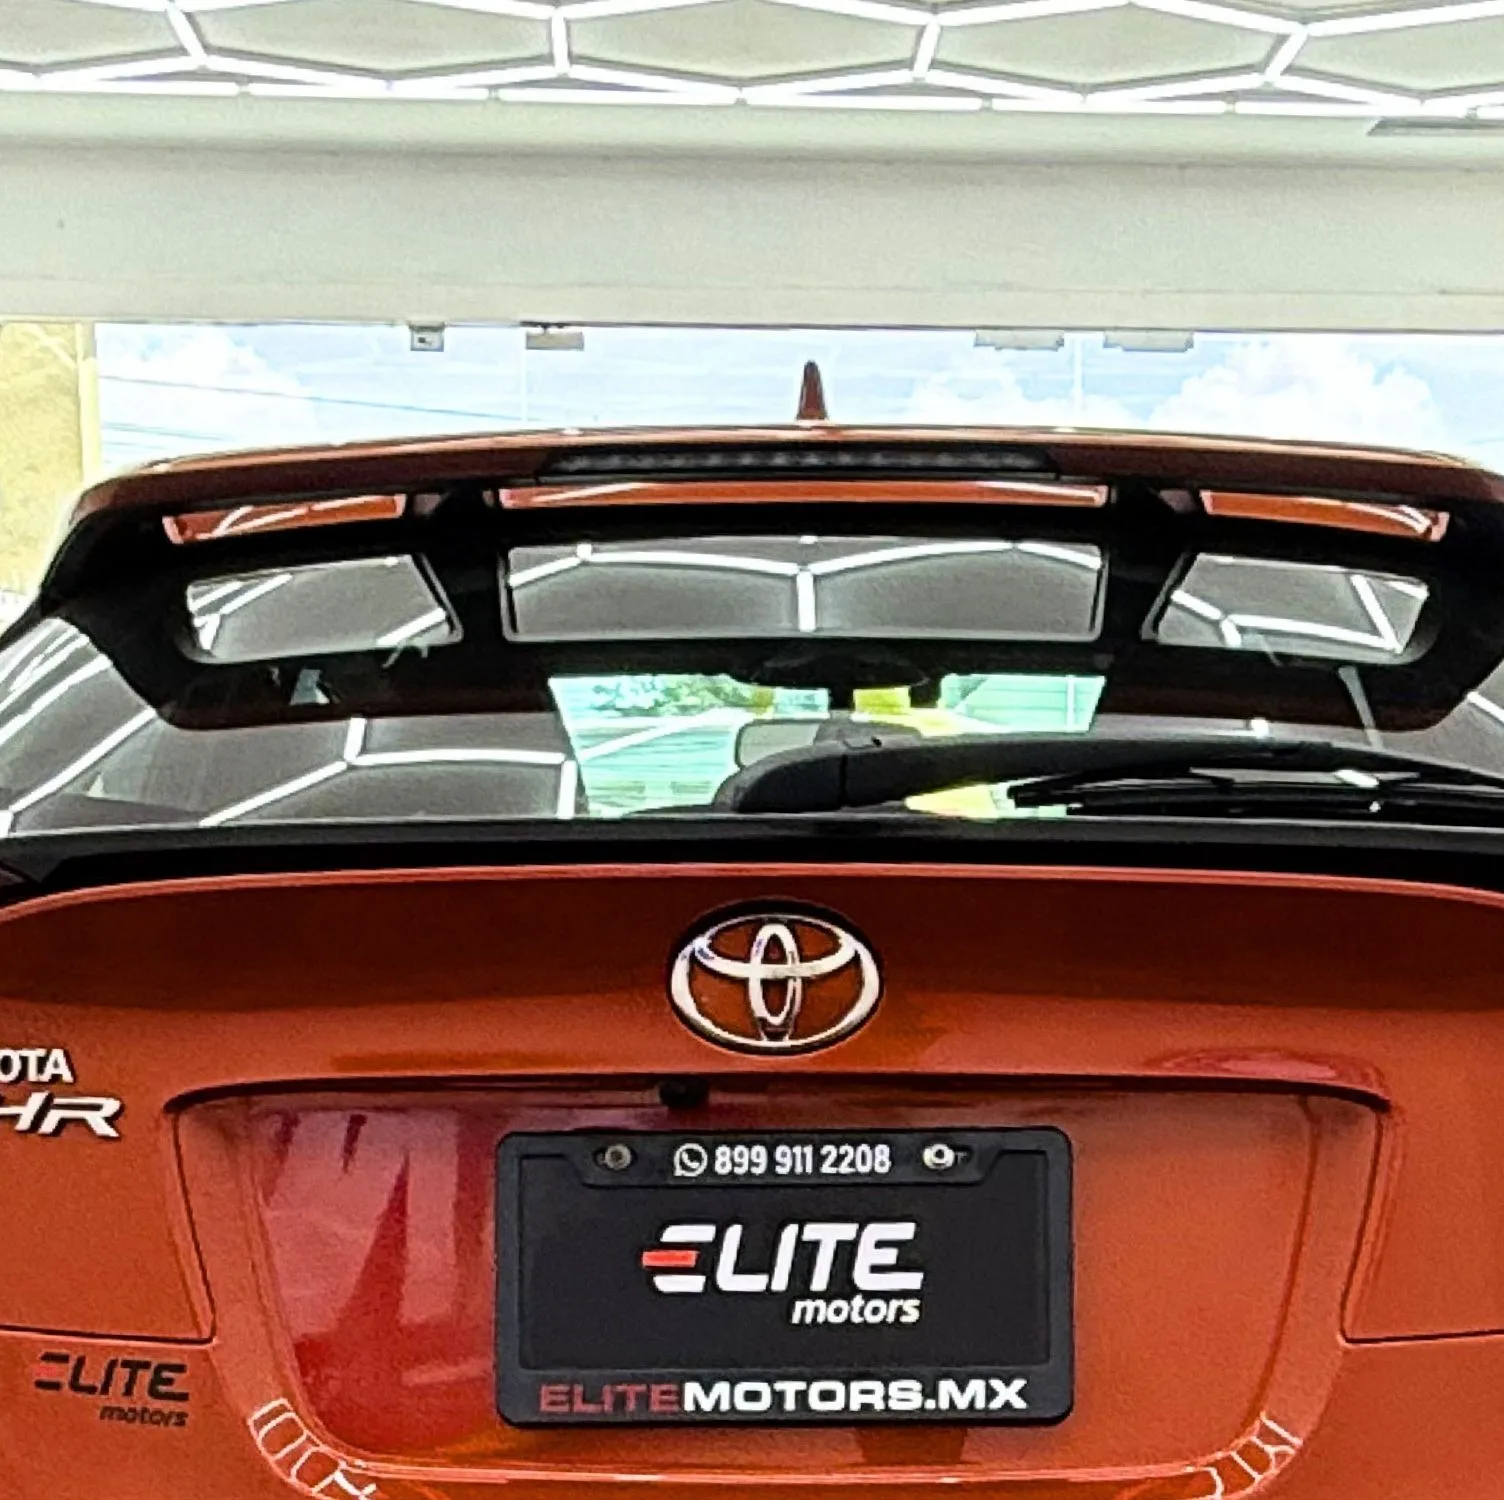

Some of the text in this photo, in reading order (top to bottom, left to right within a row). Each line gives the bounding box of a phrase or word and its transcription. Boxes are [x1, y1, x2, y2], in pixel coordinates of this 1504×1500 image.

[714, 1143, 892, 1176] 899 911 2208
[642, 1222, 924, 1293] ELITE
[791, 1295, 921, 1325] motors
[33, 1351, 190, 1402] ELITE
[539, 1378, 1028, 1414] ELITEMOTORS.MX
[98, 1405, 189, 1428] motors
